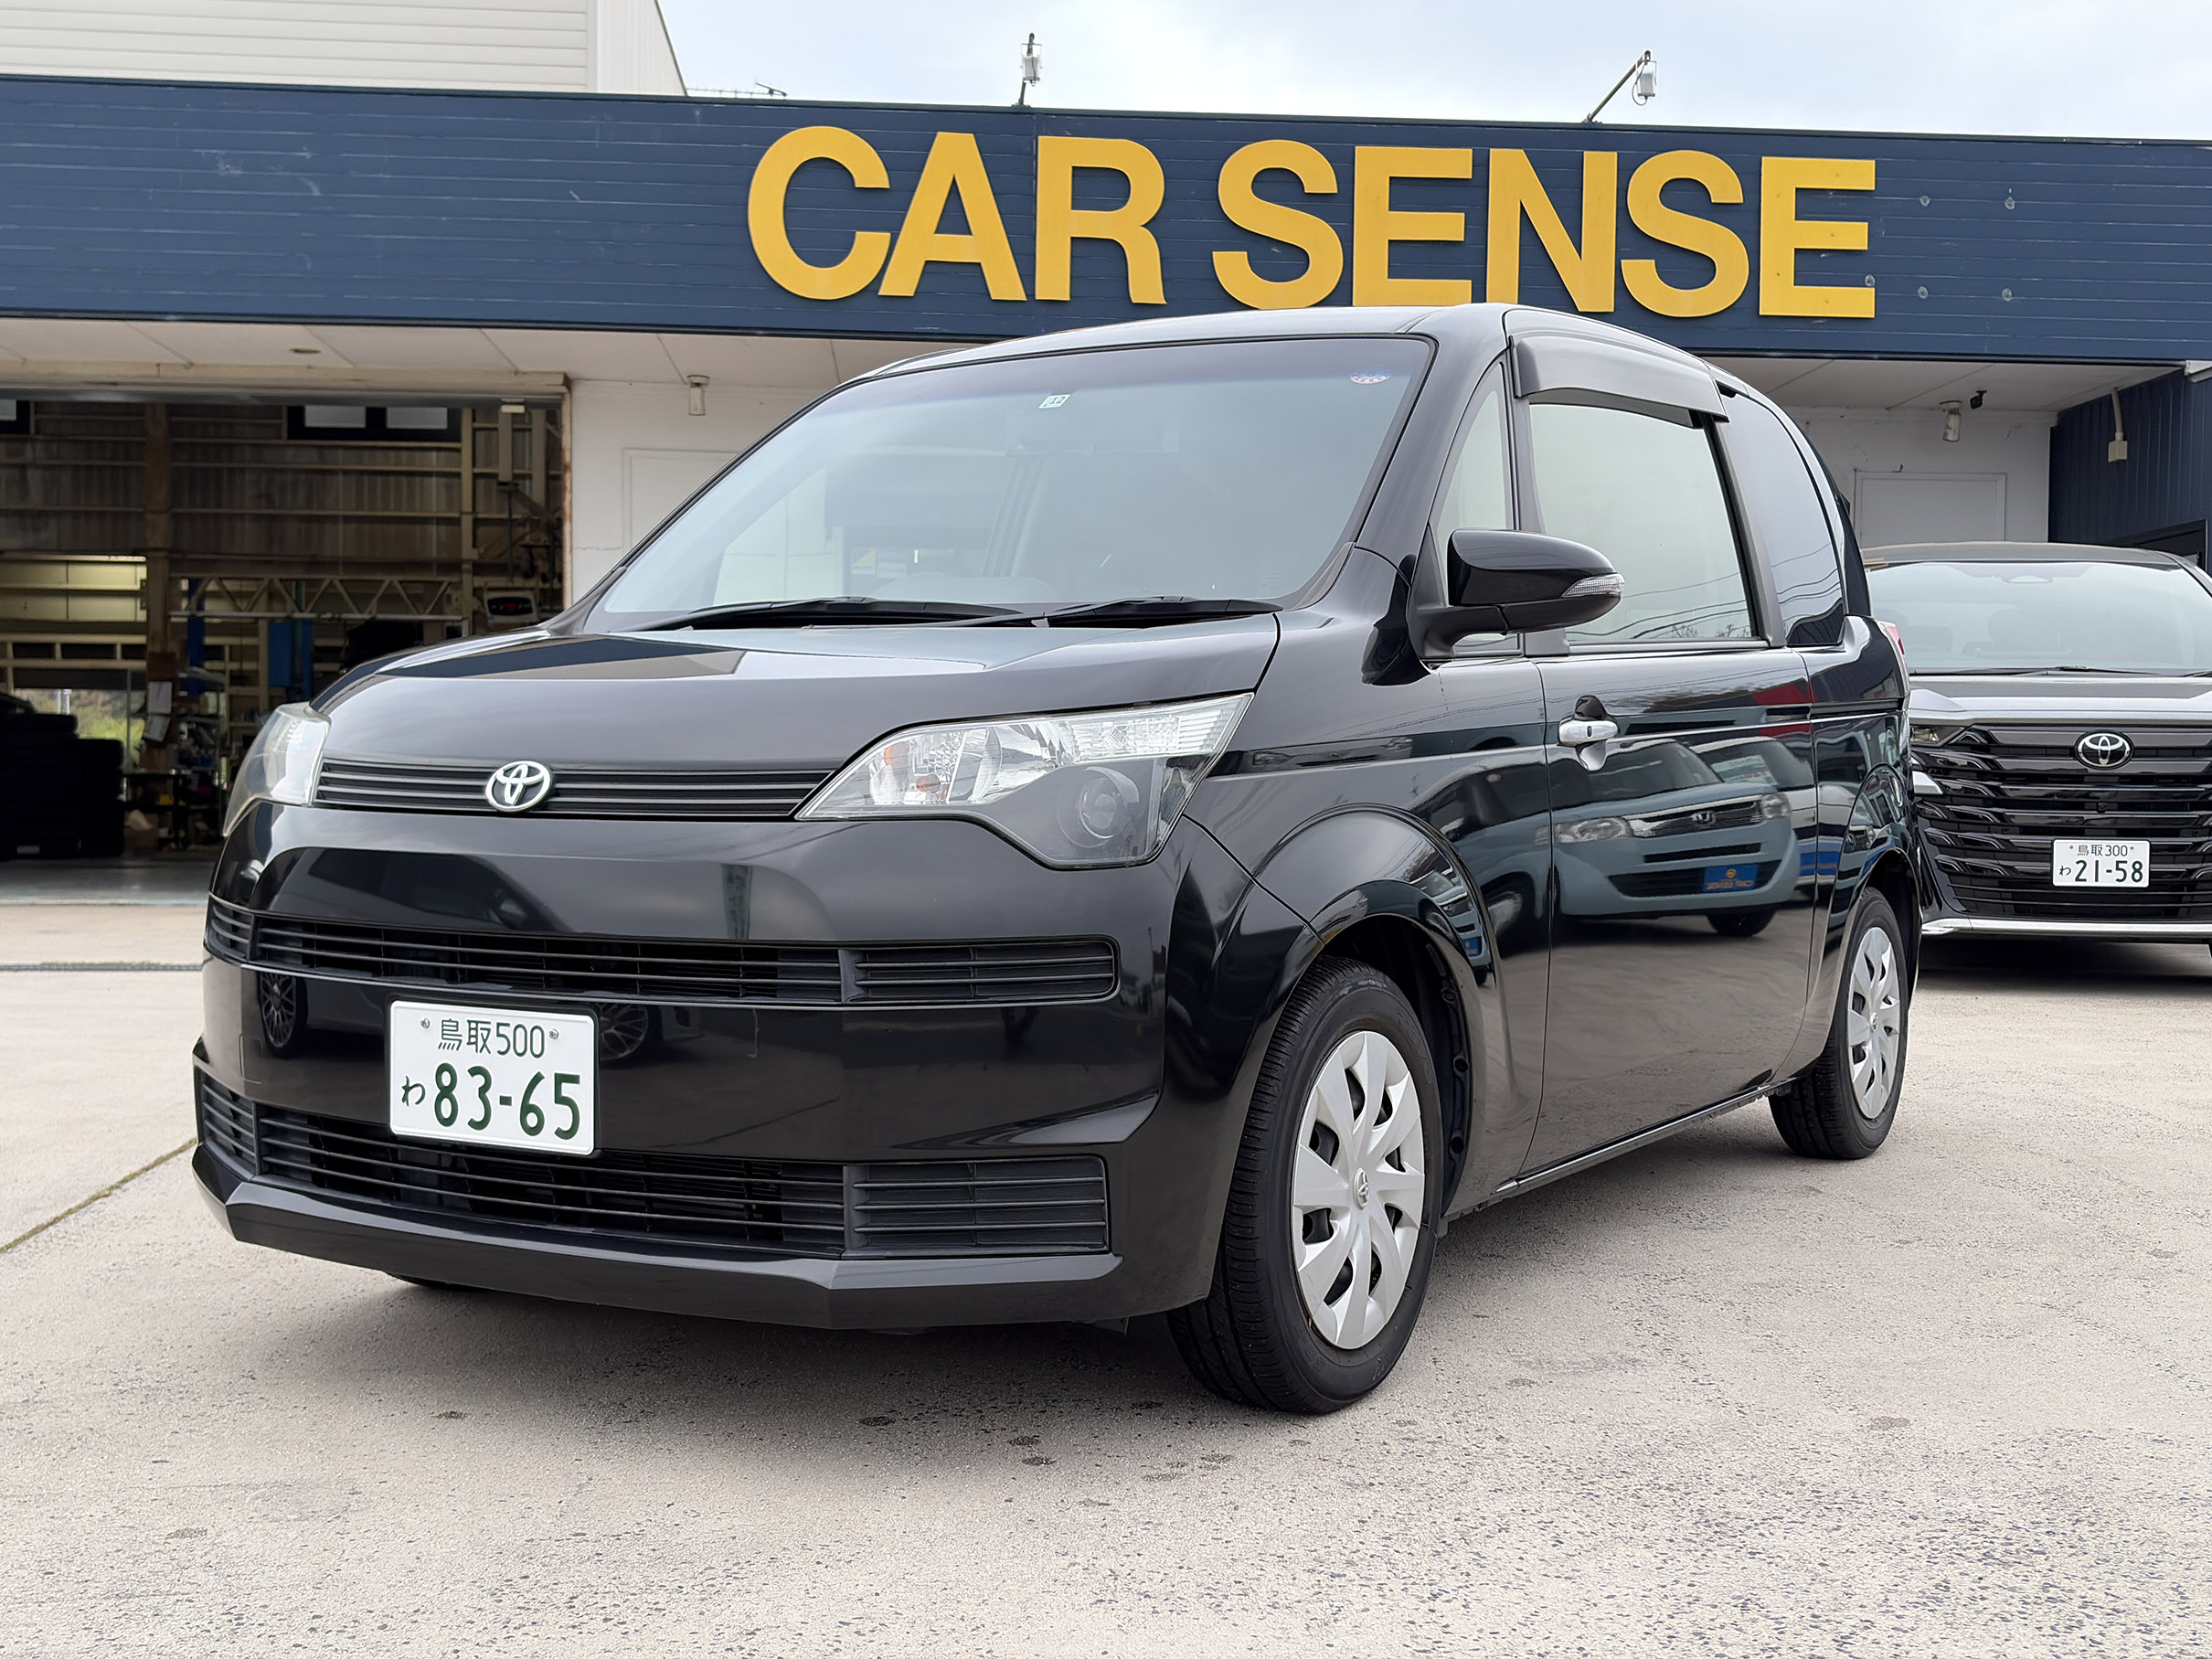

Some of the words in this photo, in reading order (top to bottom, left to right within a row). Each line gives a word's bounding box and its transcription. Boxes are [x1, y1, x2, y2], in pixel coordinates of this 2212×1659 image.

[748, 125, 1167, 304] CAR
[1212, 139, 1876, 318] SENSE
[2077, 844, 2128, 857] 鳥取300
[2058, 865, 2071, 876] わ
[2075, 859, 2143, 883] 21-58
[438, 1018, 545, 1058] 鳥取500
[401, 1075, 426, 1107] わ
[434, 1062, 580, 1140] 83-65
